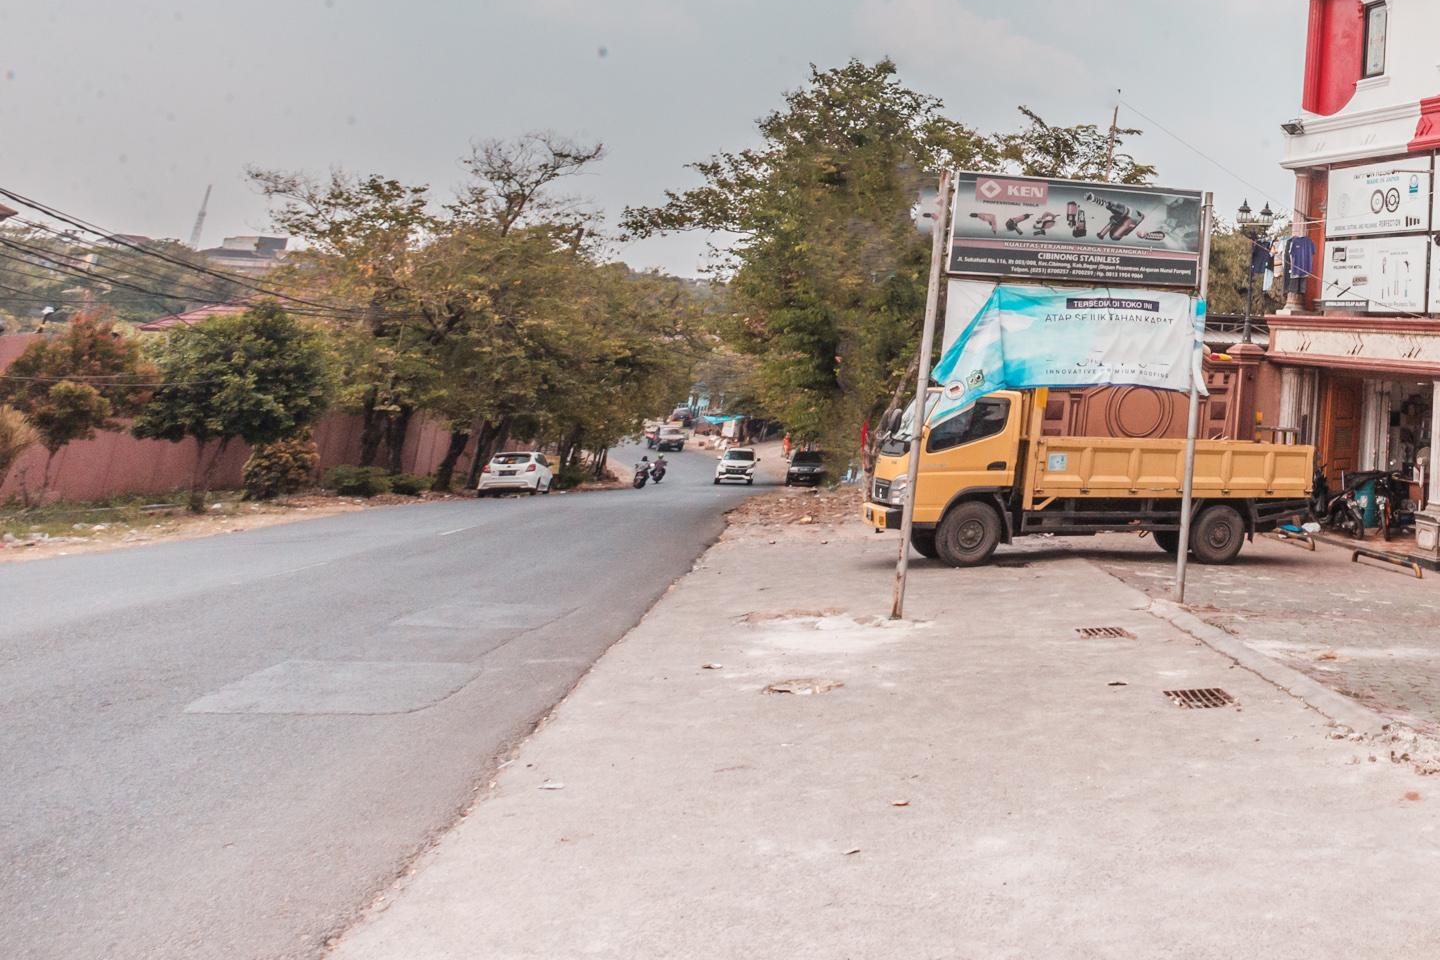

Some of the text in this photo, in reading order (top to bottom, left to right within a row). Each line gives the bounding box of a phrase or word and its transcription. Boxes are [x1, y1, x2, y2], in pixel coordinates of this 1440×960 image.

[1007, 184, 1044, 198] KEN
[1004, 240, 1040, 249] KUALITAS
[1037, 252, 1121, 264] CIBINONG STAINLESS
[1073, 300, 1153, 310] TERSEDIA DI TOKO INI
[1045, 313, 1072, 322] ATAP
